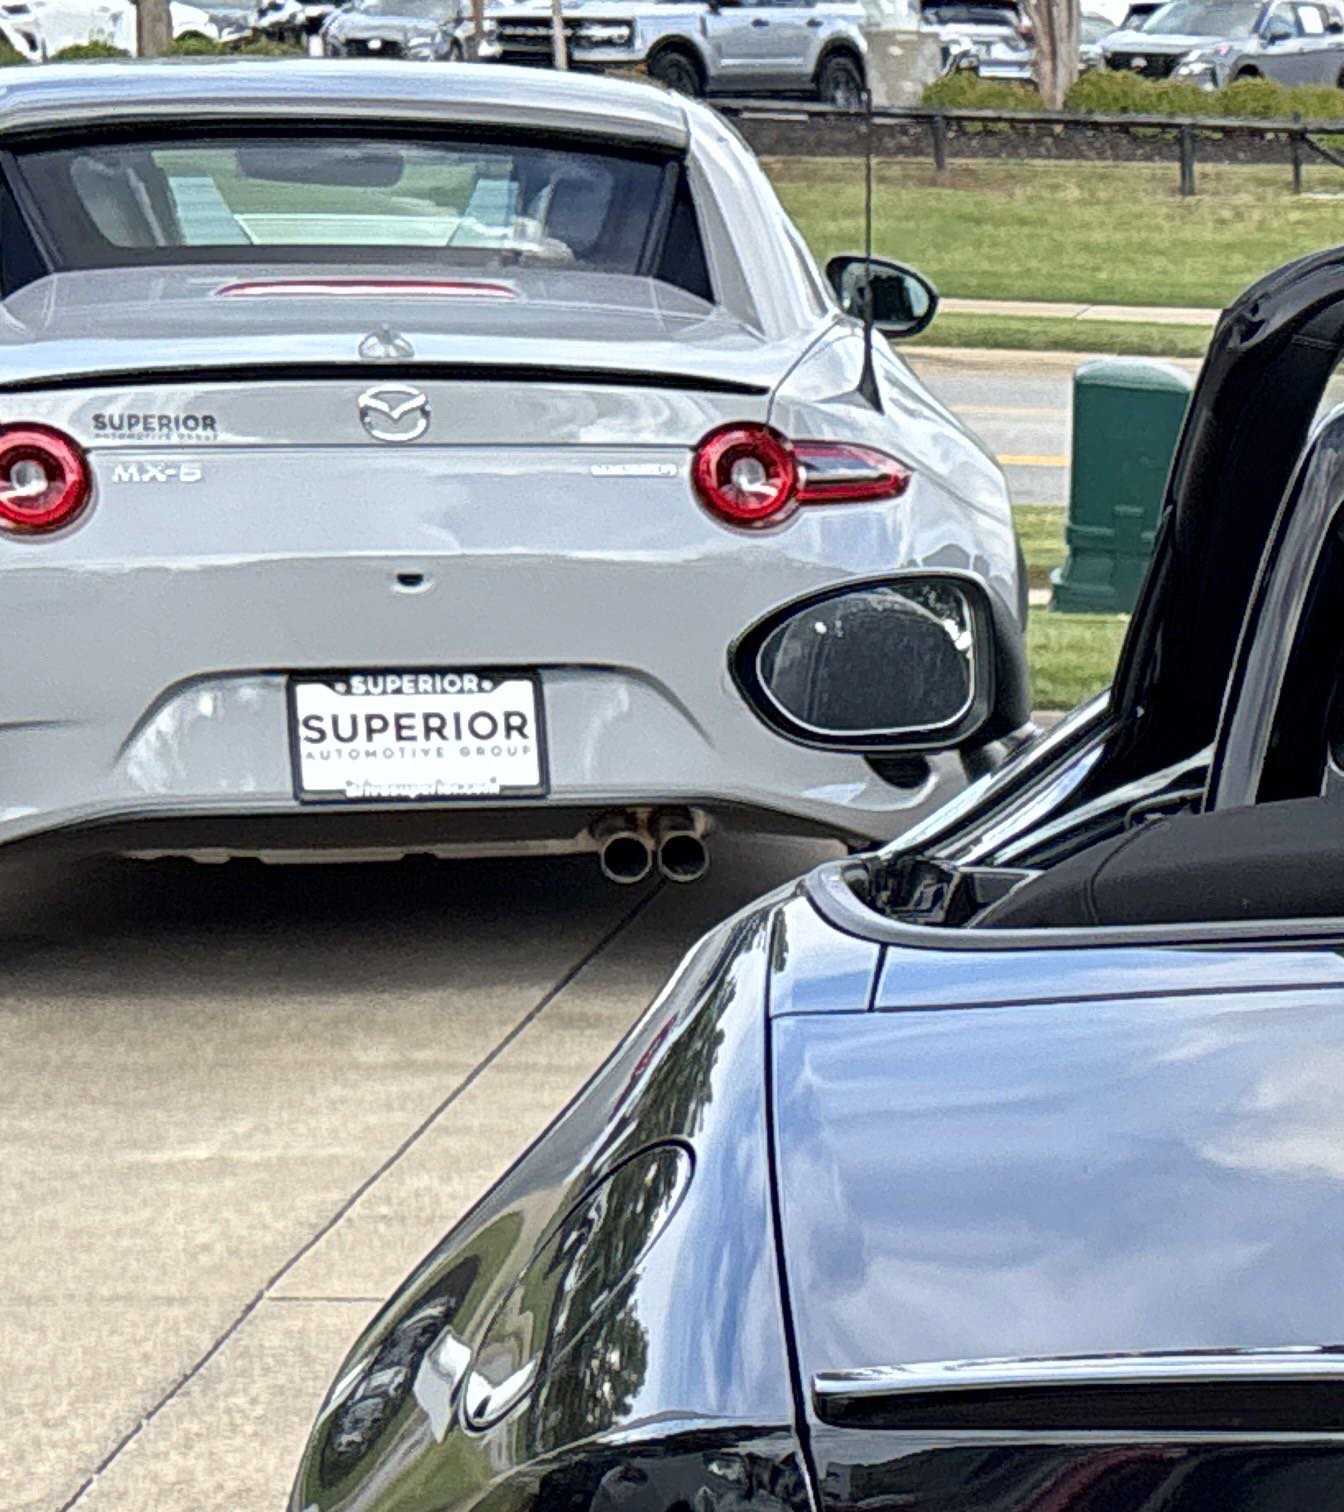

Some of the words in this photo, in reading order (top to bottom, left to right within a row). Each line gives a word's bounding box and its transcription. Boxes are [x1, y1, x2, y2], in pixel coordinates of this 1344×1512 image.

[92, 413, 217, 432] SUPERIOR
[112, 463, 202, 483] MX-5
[350, 674, 480, 694] SUPERIOR
[301, 711, 530, 744] SUPERIOR
[305, 746, 445, 761] AUTOMOTIVE
[459, 745, 531, 758] GROUP
